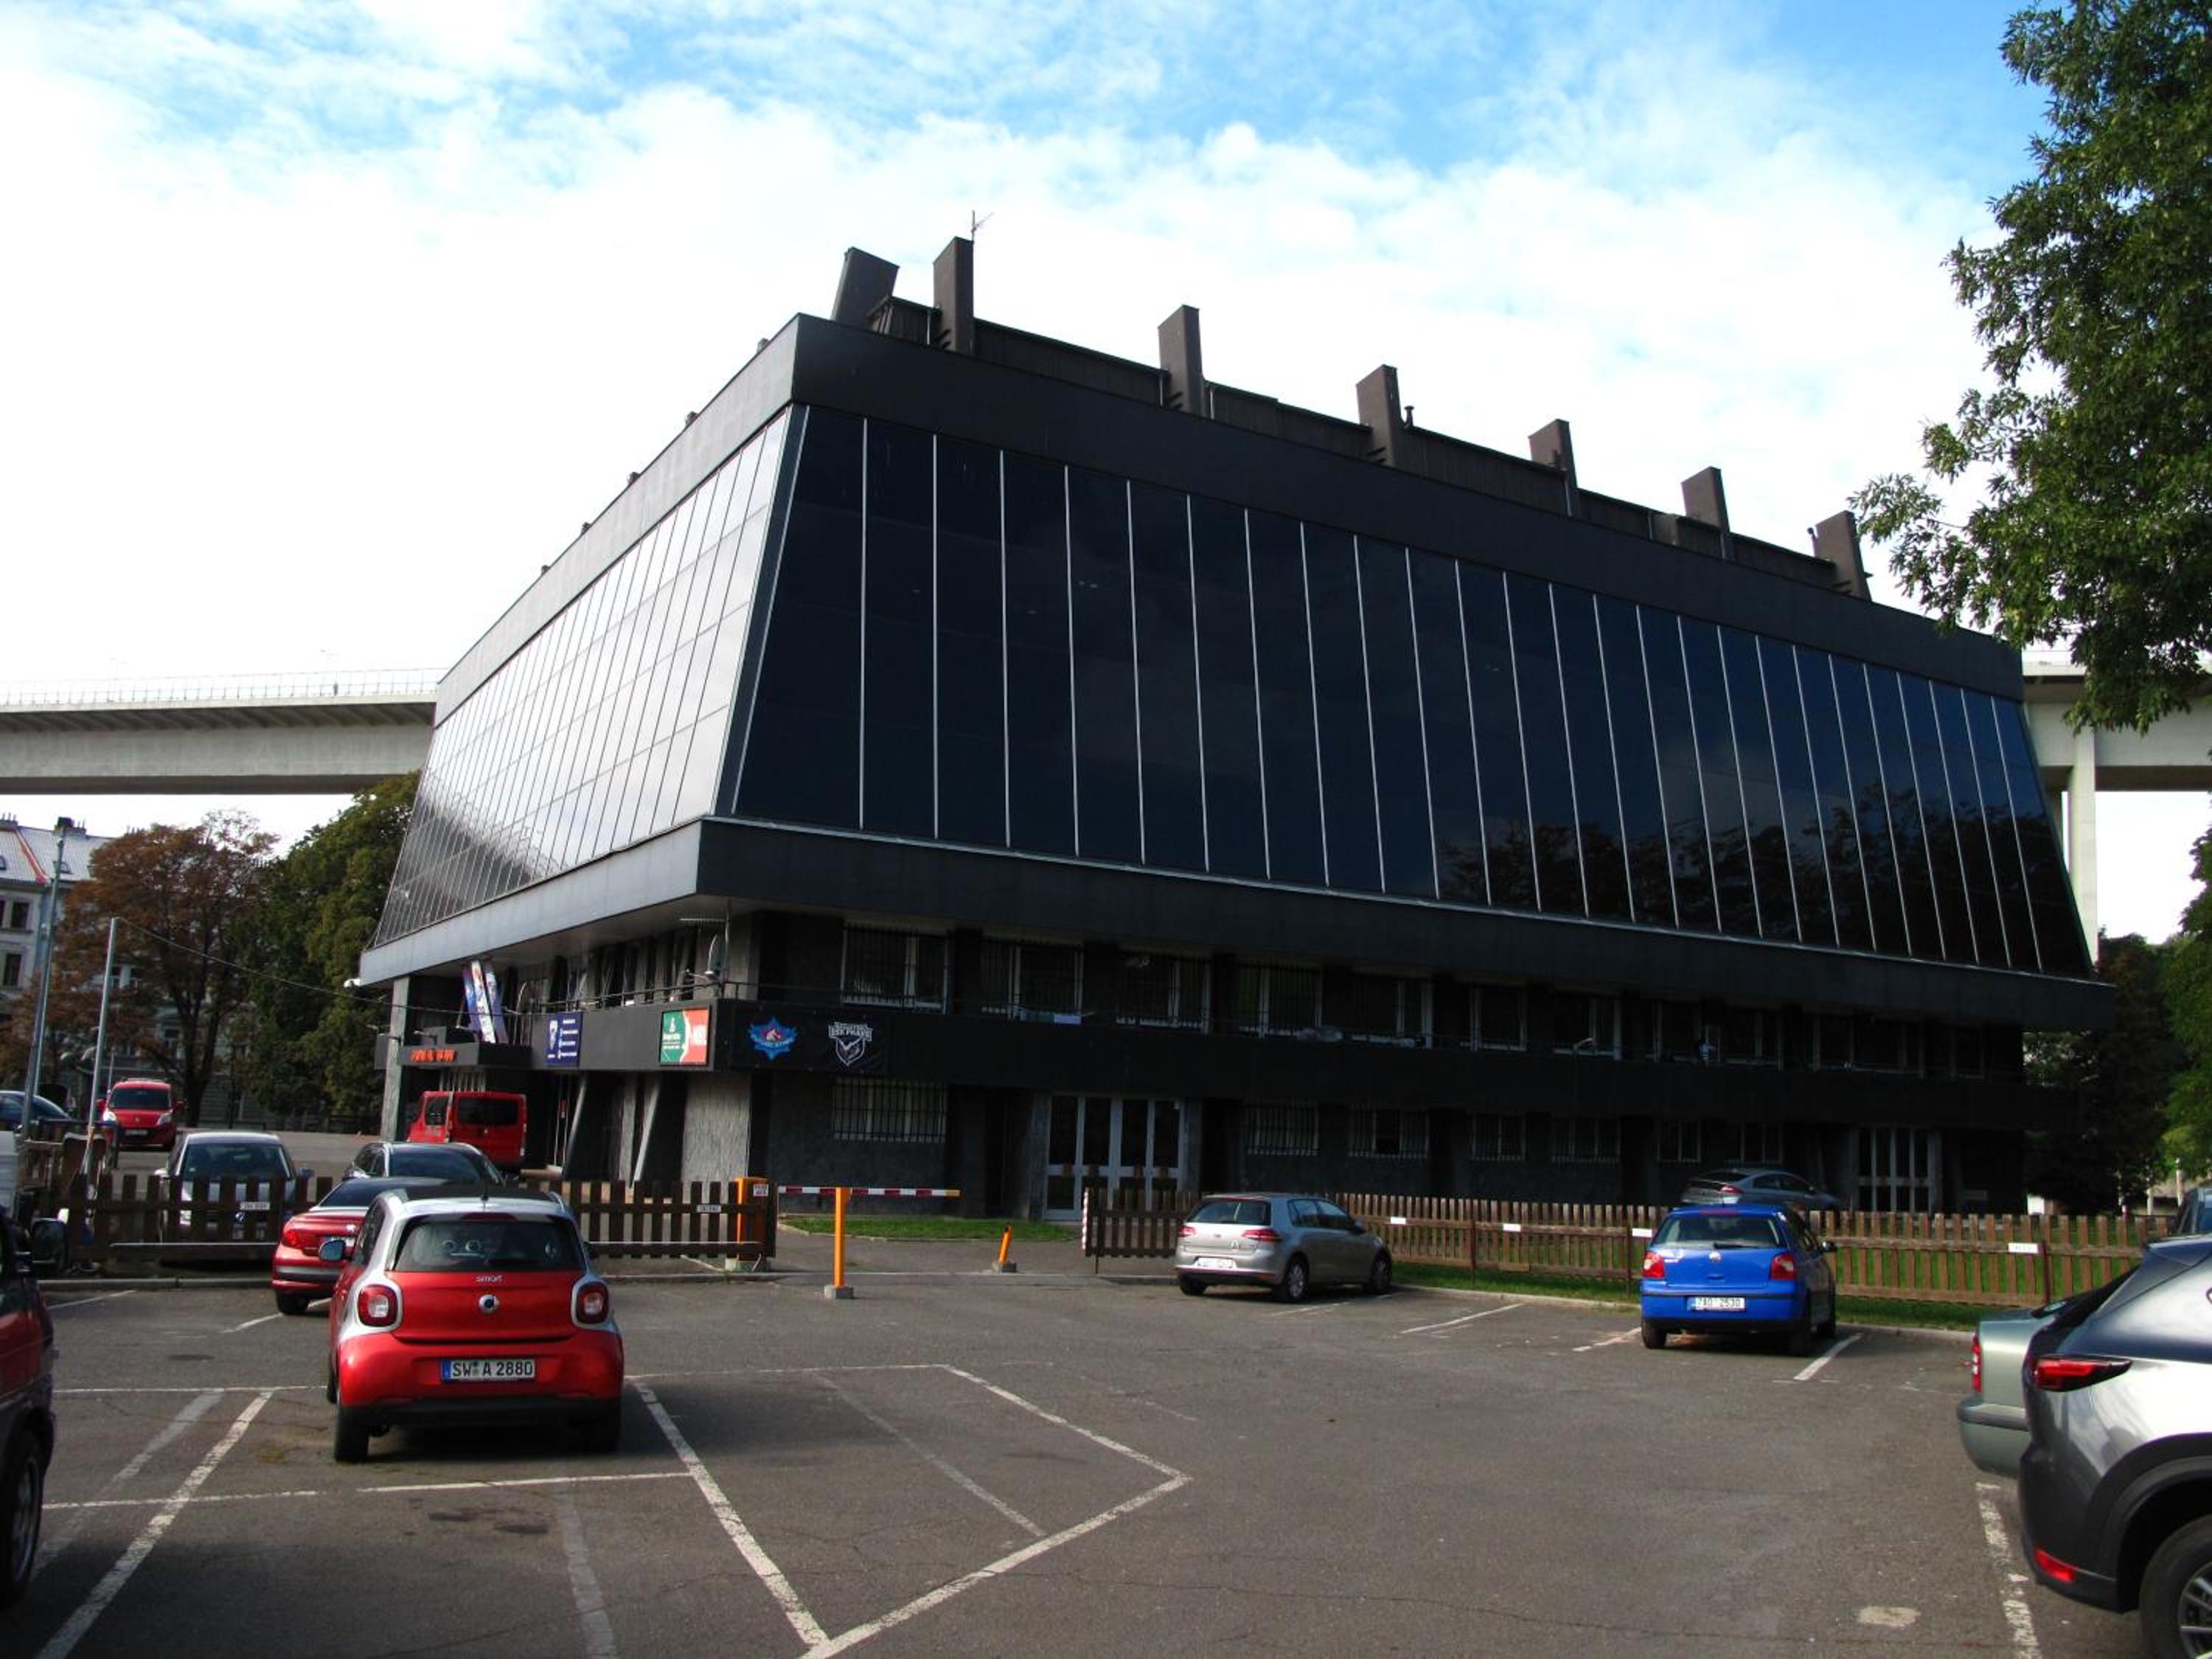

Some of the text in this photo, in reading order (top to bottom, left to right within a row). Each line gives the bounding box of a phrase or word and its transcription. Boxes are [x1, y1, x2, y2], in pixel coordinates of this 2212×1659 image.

[453, 1361, 533, 1377] SW A 2880
